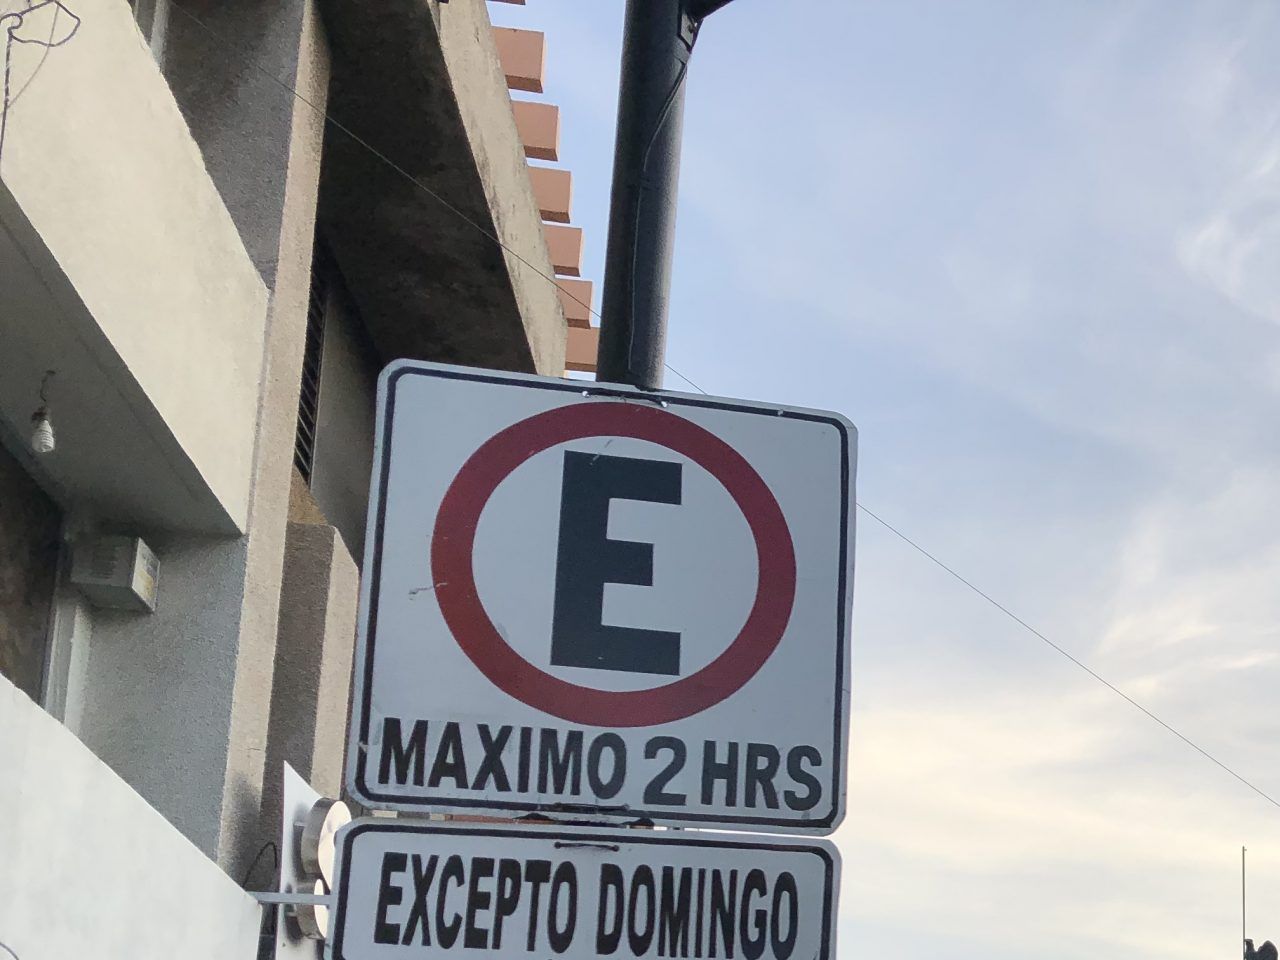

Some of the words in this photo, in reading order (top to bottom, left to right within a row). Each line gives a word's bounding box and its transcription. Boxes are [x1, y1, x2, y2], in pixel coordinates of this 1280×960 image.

[550, 450, 683, 676] E
[377, 717, 628, 800] MAXIMO
[643, 735, 688, 807] 2
[700, 741, 824, 812] HRS
[373, 851, 578, 955] EXCEPTO
